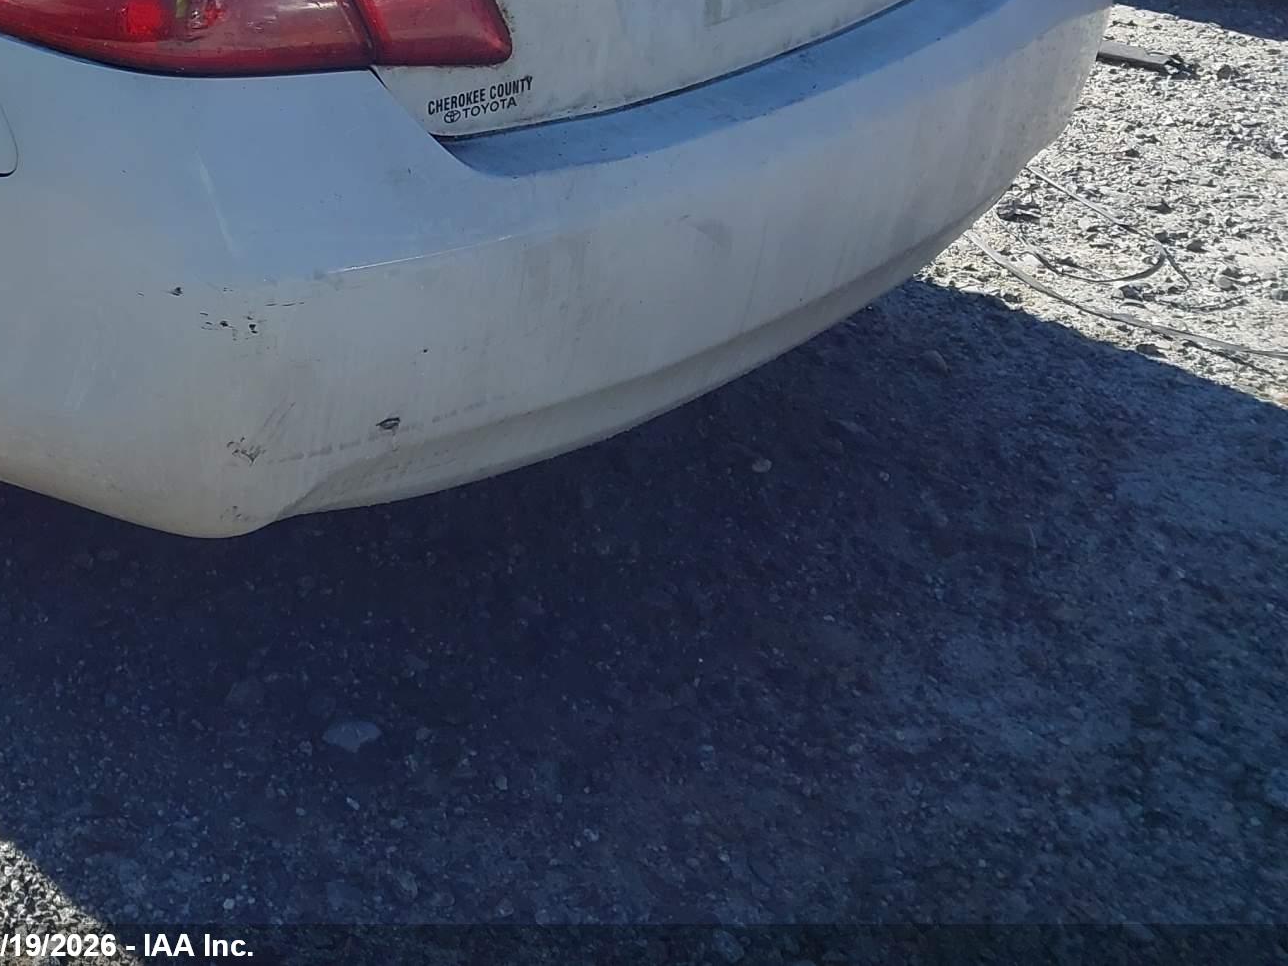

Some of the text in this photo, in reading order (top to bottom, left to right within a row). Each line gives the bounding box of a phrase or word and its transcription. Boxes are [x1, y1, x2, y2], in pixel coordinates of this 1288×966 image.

[427, 75, 533, 116] CHEROKEE COUNTY
[462, 96, 518, 119] TOYOTA
